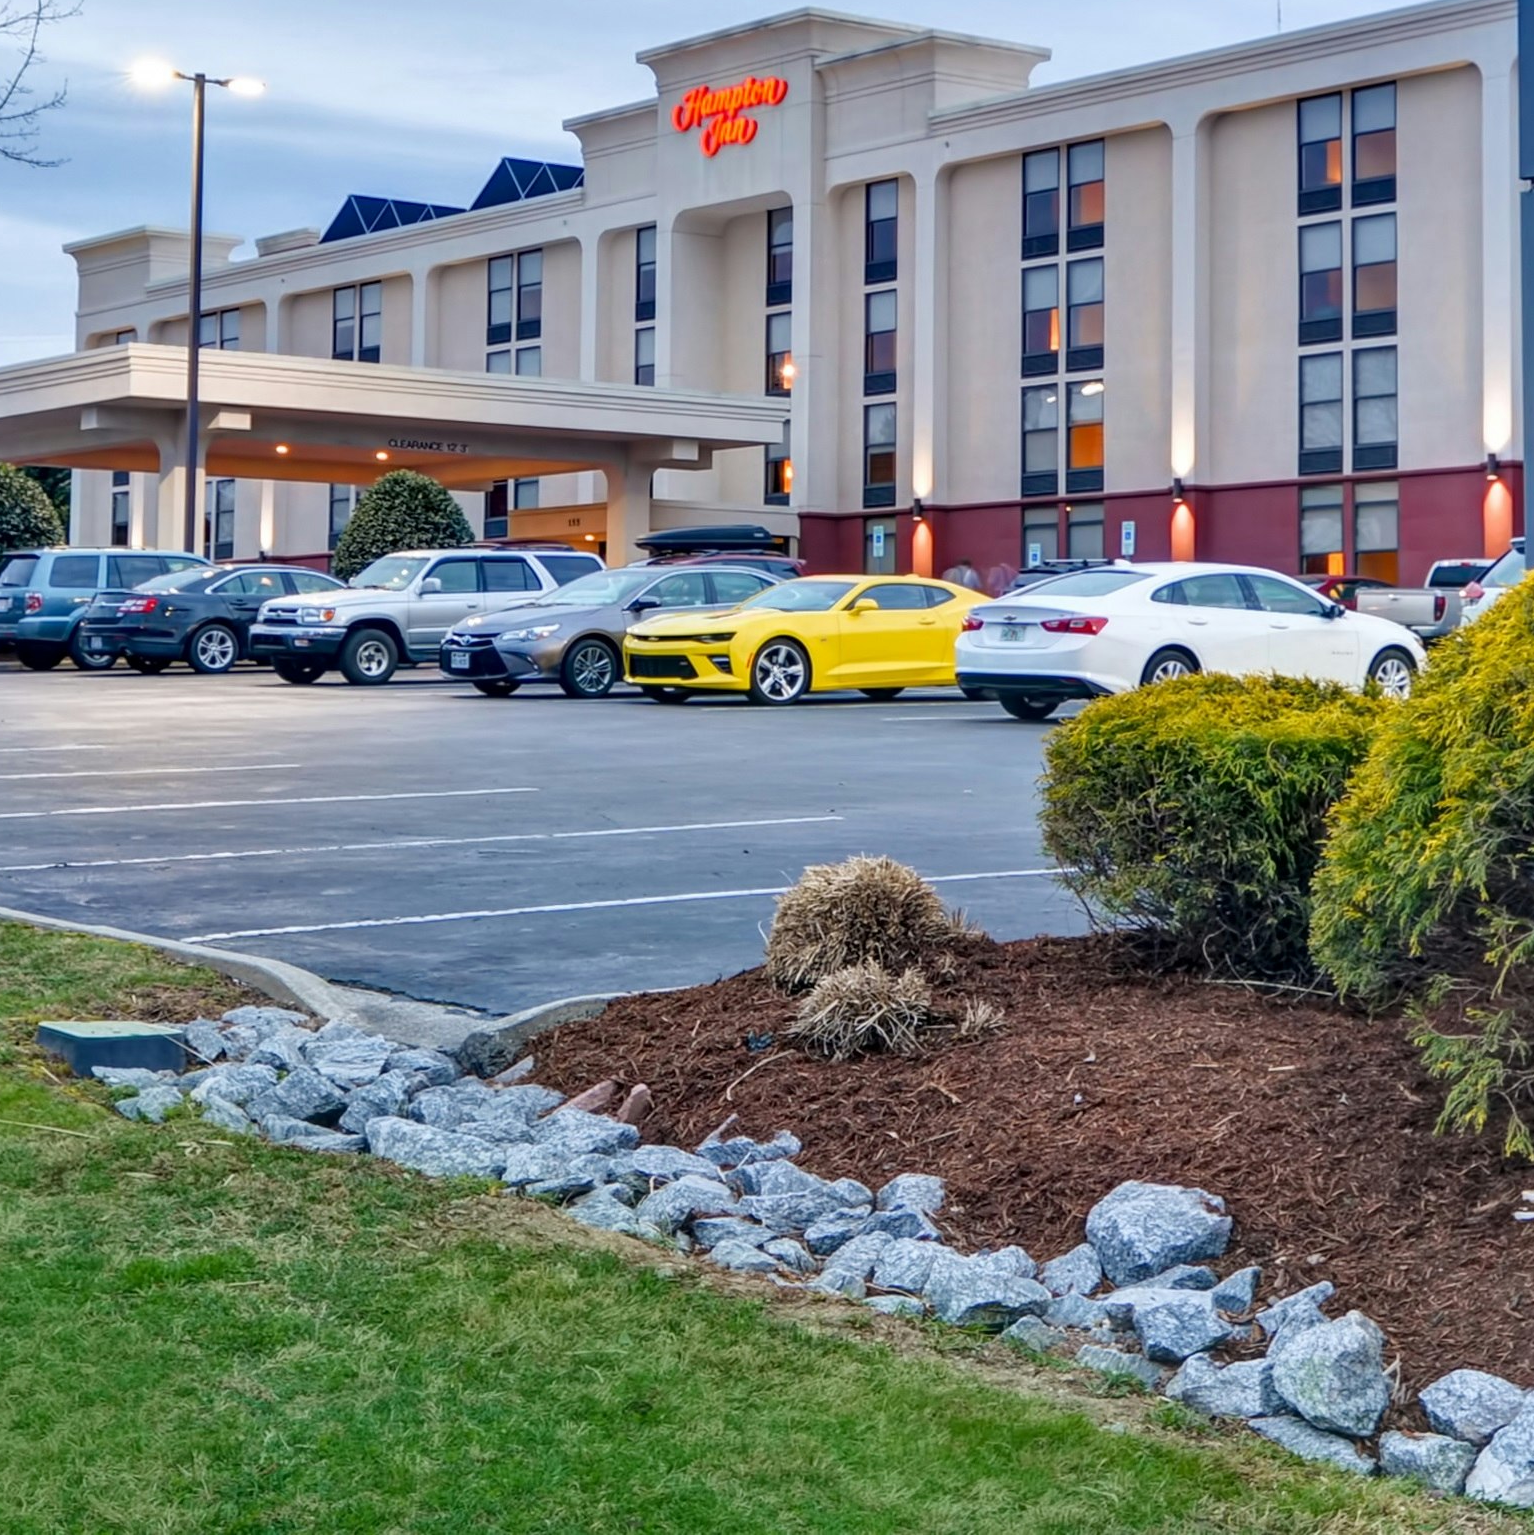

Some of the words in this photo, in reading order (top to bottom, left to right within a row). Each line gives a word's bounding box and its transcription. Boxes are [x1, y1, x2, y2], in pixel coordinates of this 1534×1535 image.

[671, 75, 789, 133] Hampton
[700, 115, 758, 158] Inn
[388, 438, 443, 451] CLEARANCE
